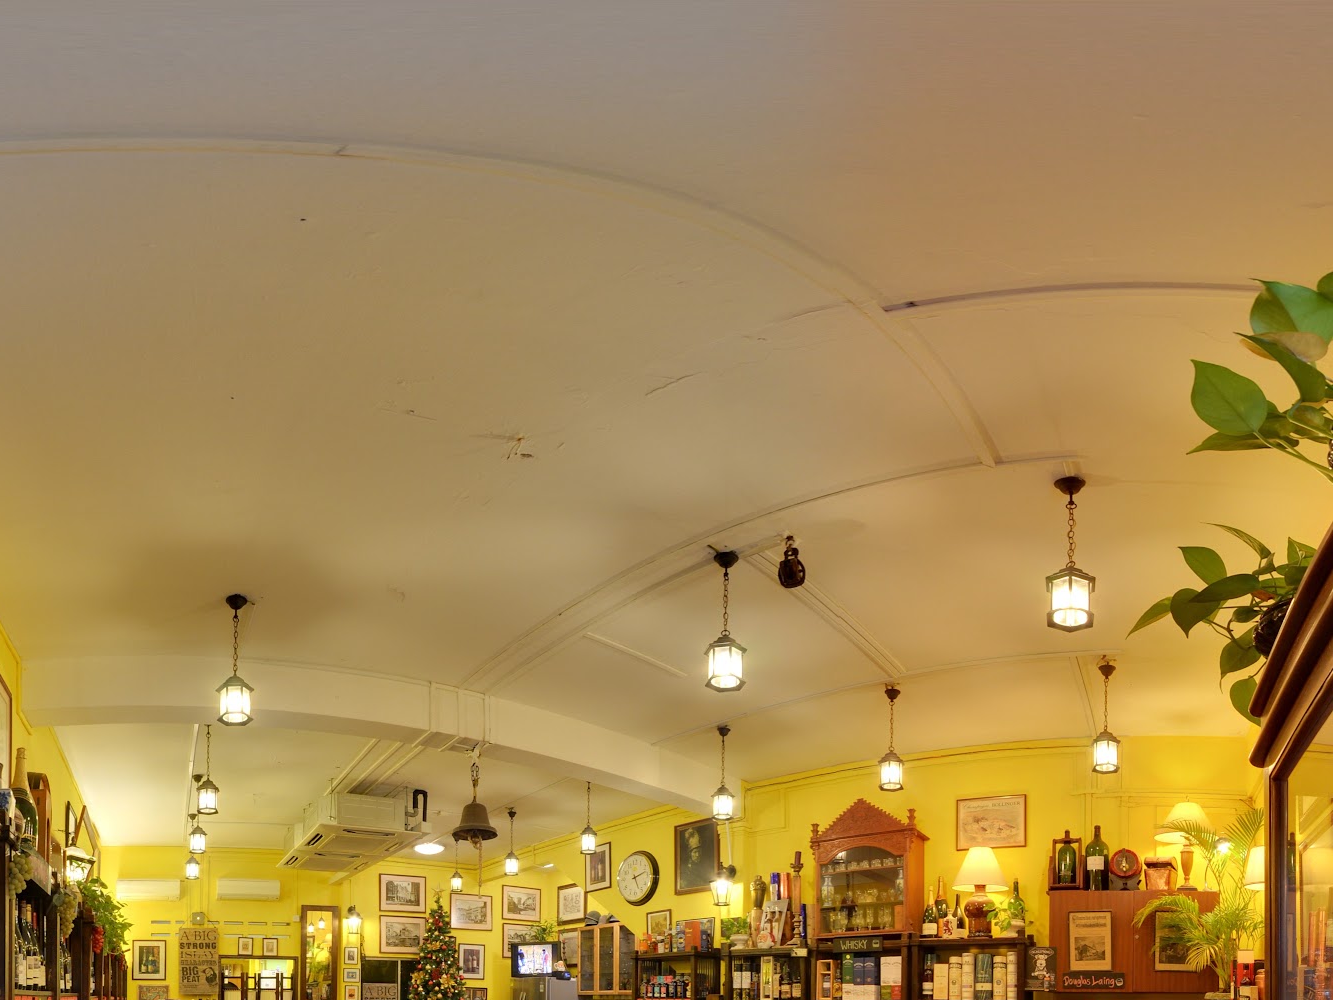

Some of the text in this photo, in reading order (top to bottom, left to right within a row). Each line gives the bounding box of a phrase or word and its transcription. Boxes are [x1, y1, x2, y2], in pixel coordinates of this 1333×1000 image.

[180, 930, 217, 941] A BIG
[179, 942, 217, 950] STRONG
[840, 939, 868, 950] WHISKY
[181, 966, 199, 976] BIG
[181, 975, 201, 983] PEAT
[1063, 975, 1115, 988] Douglas Laing
[364, 985, 397, 997] A BIG
